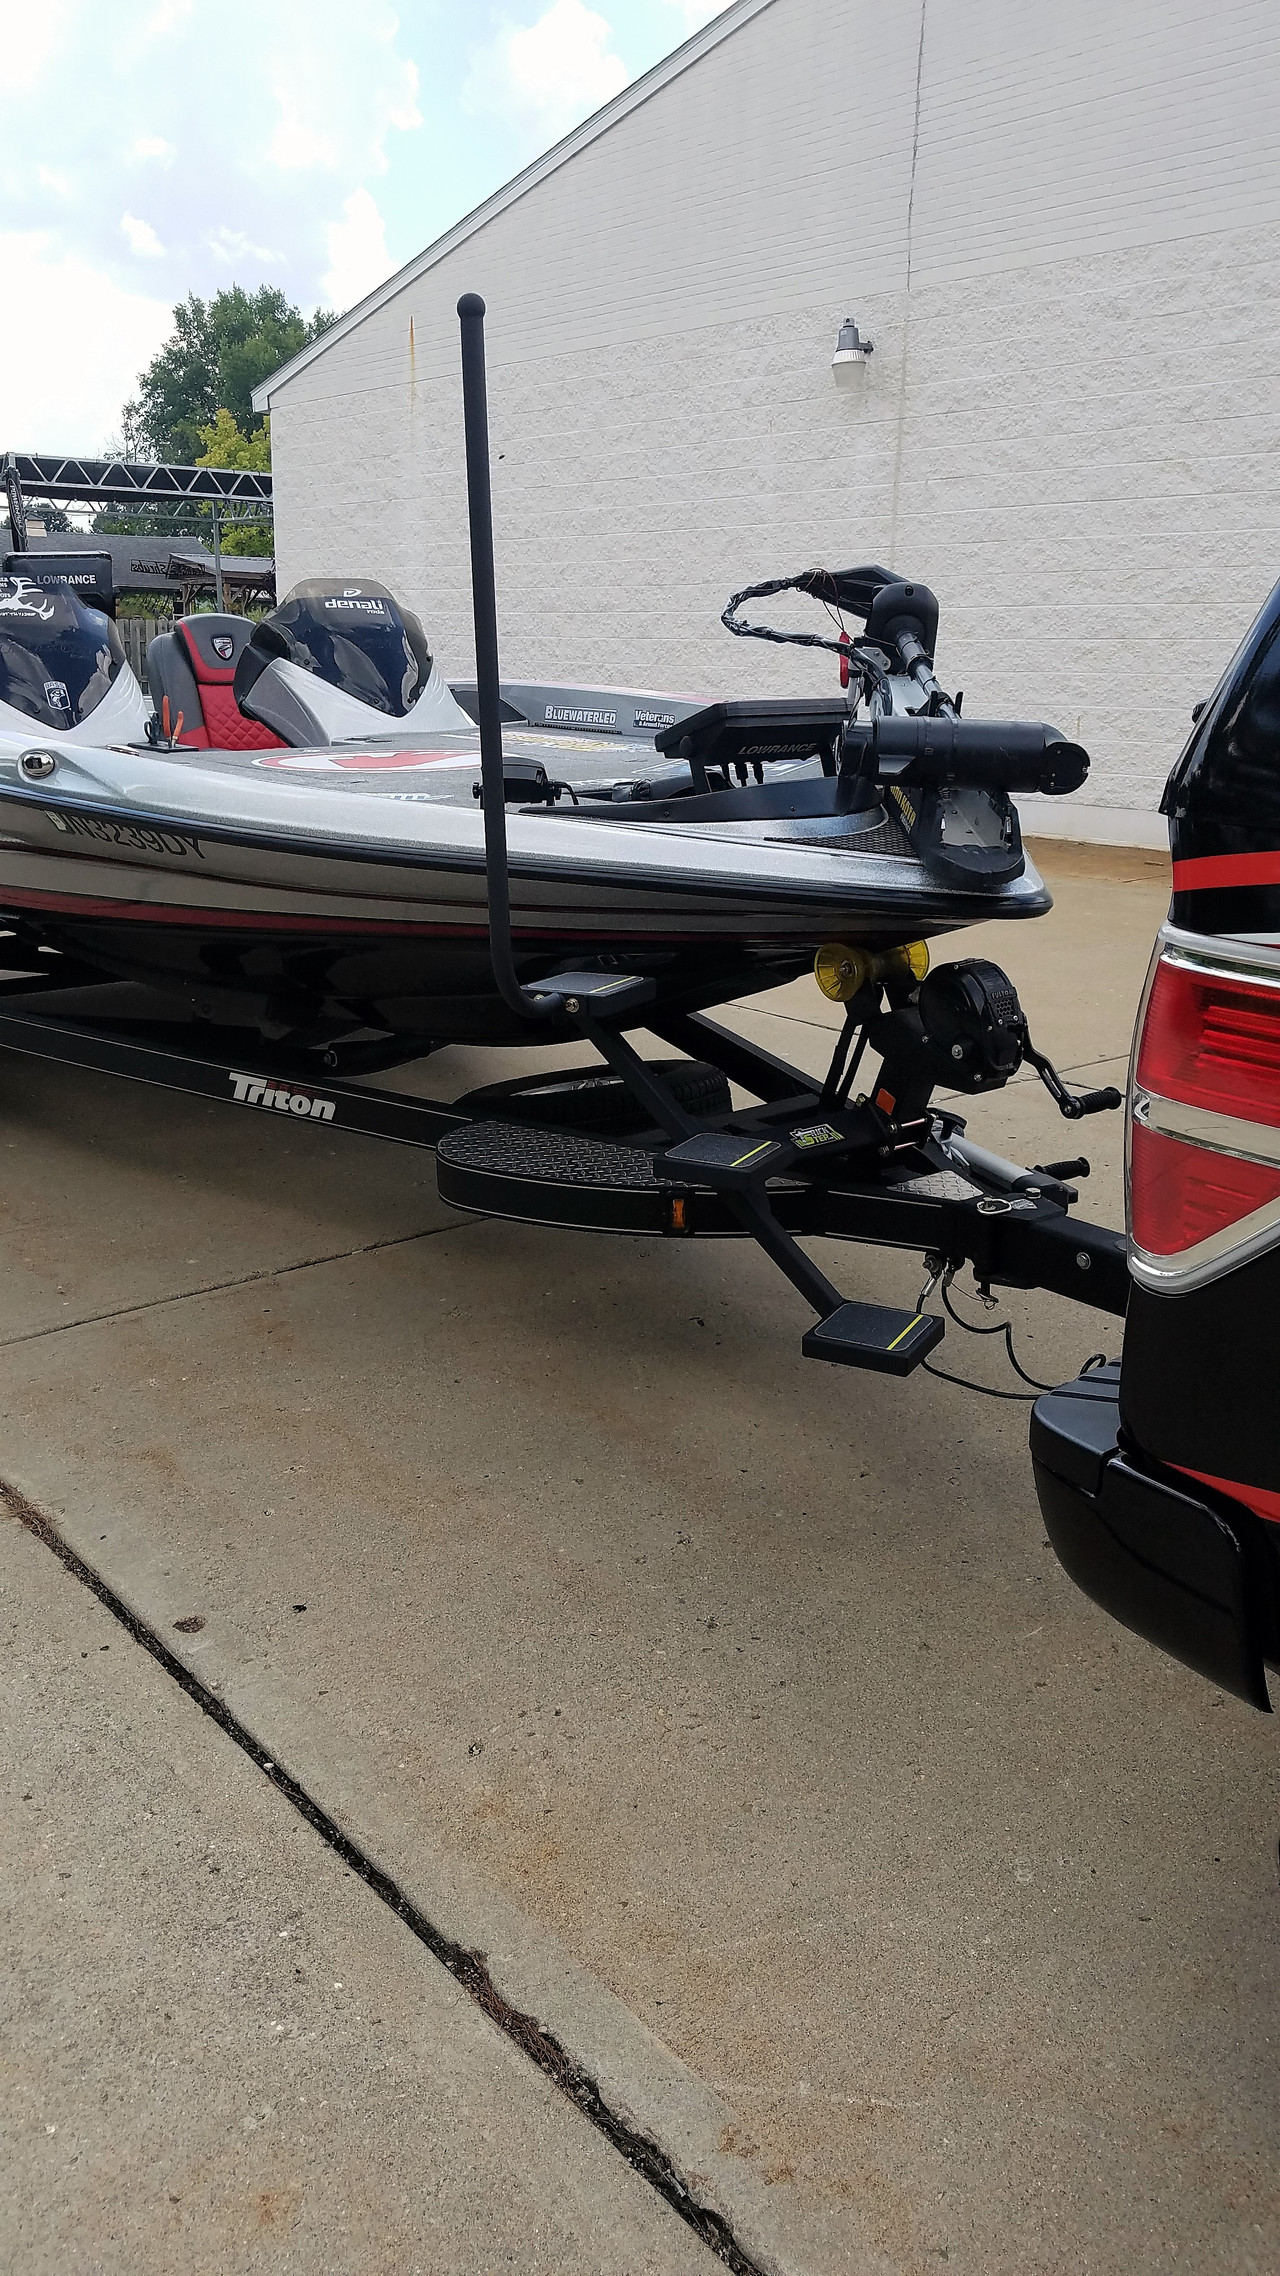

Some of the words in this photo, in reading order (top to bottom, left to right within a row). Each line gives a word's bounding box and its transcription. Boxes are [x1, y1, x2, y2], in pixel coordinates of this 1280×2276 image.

[37, 574, 97, 585] LOWRANCE
[324, 599, 383, 610] denali
[634, 709, 676, 724] Veterans
[738, 743, 817, 755] LOWRANCE
[228, 1071, 337, 1121] Triton
